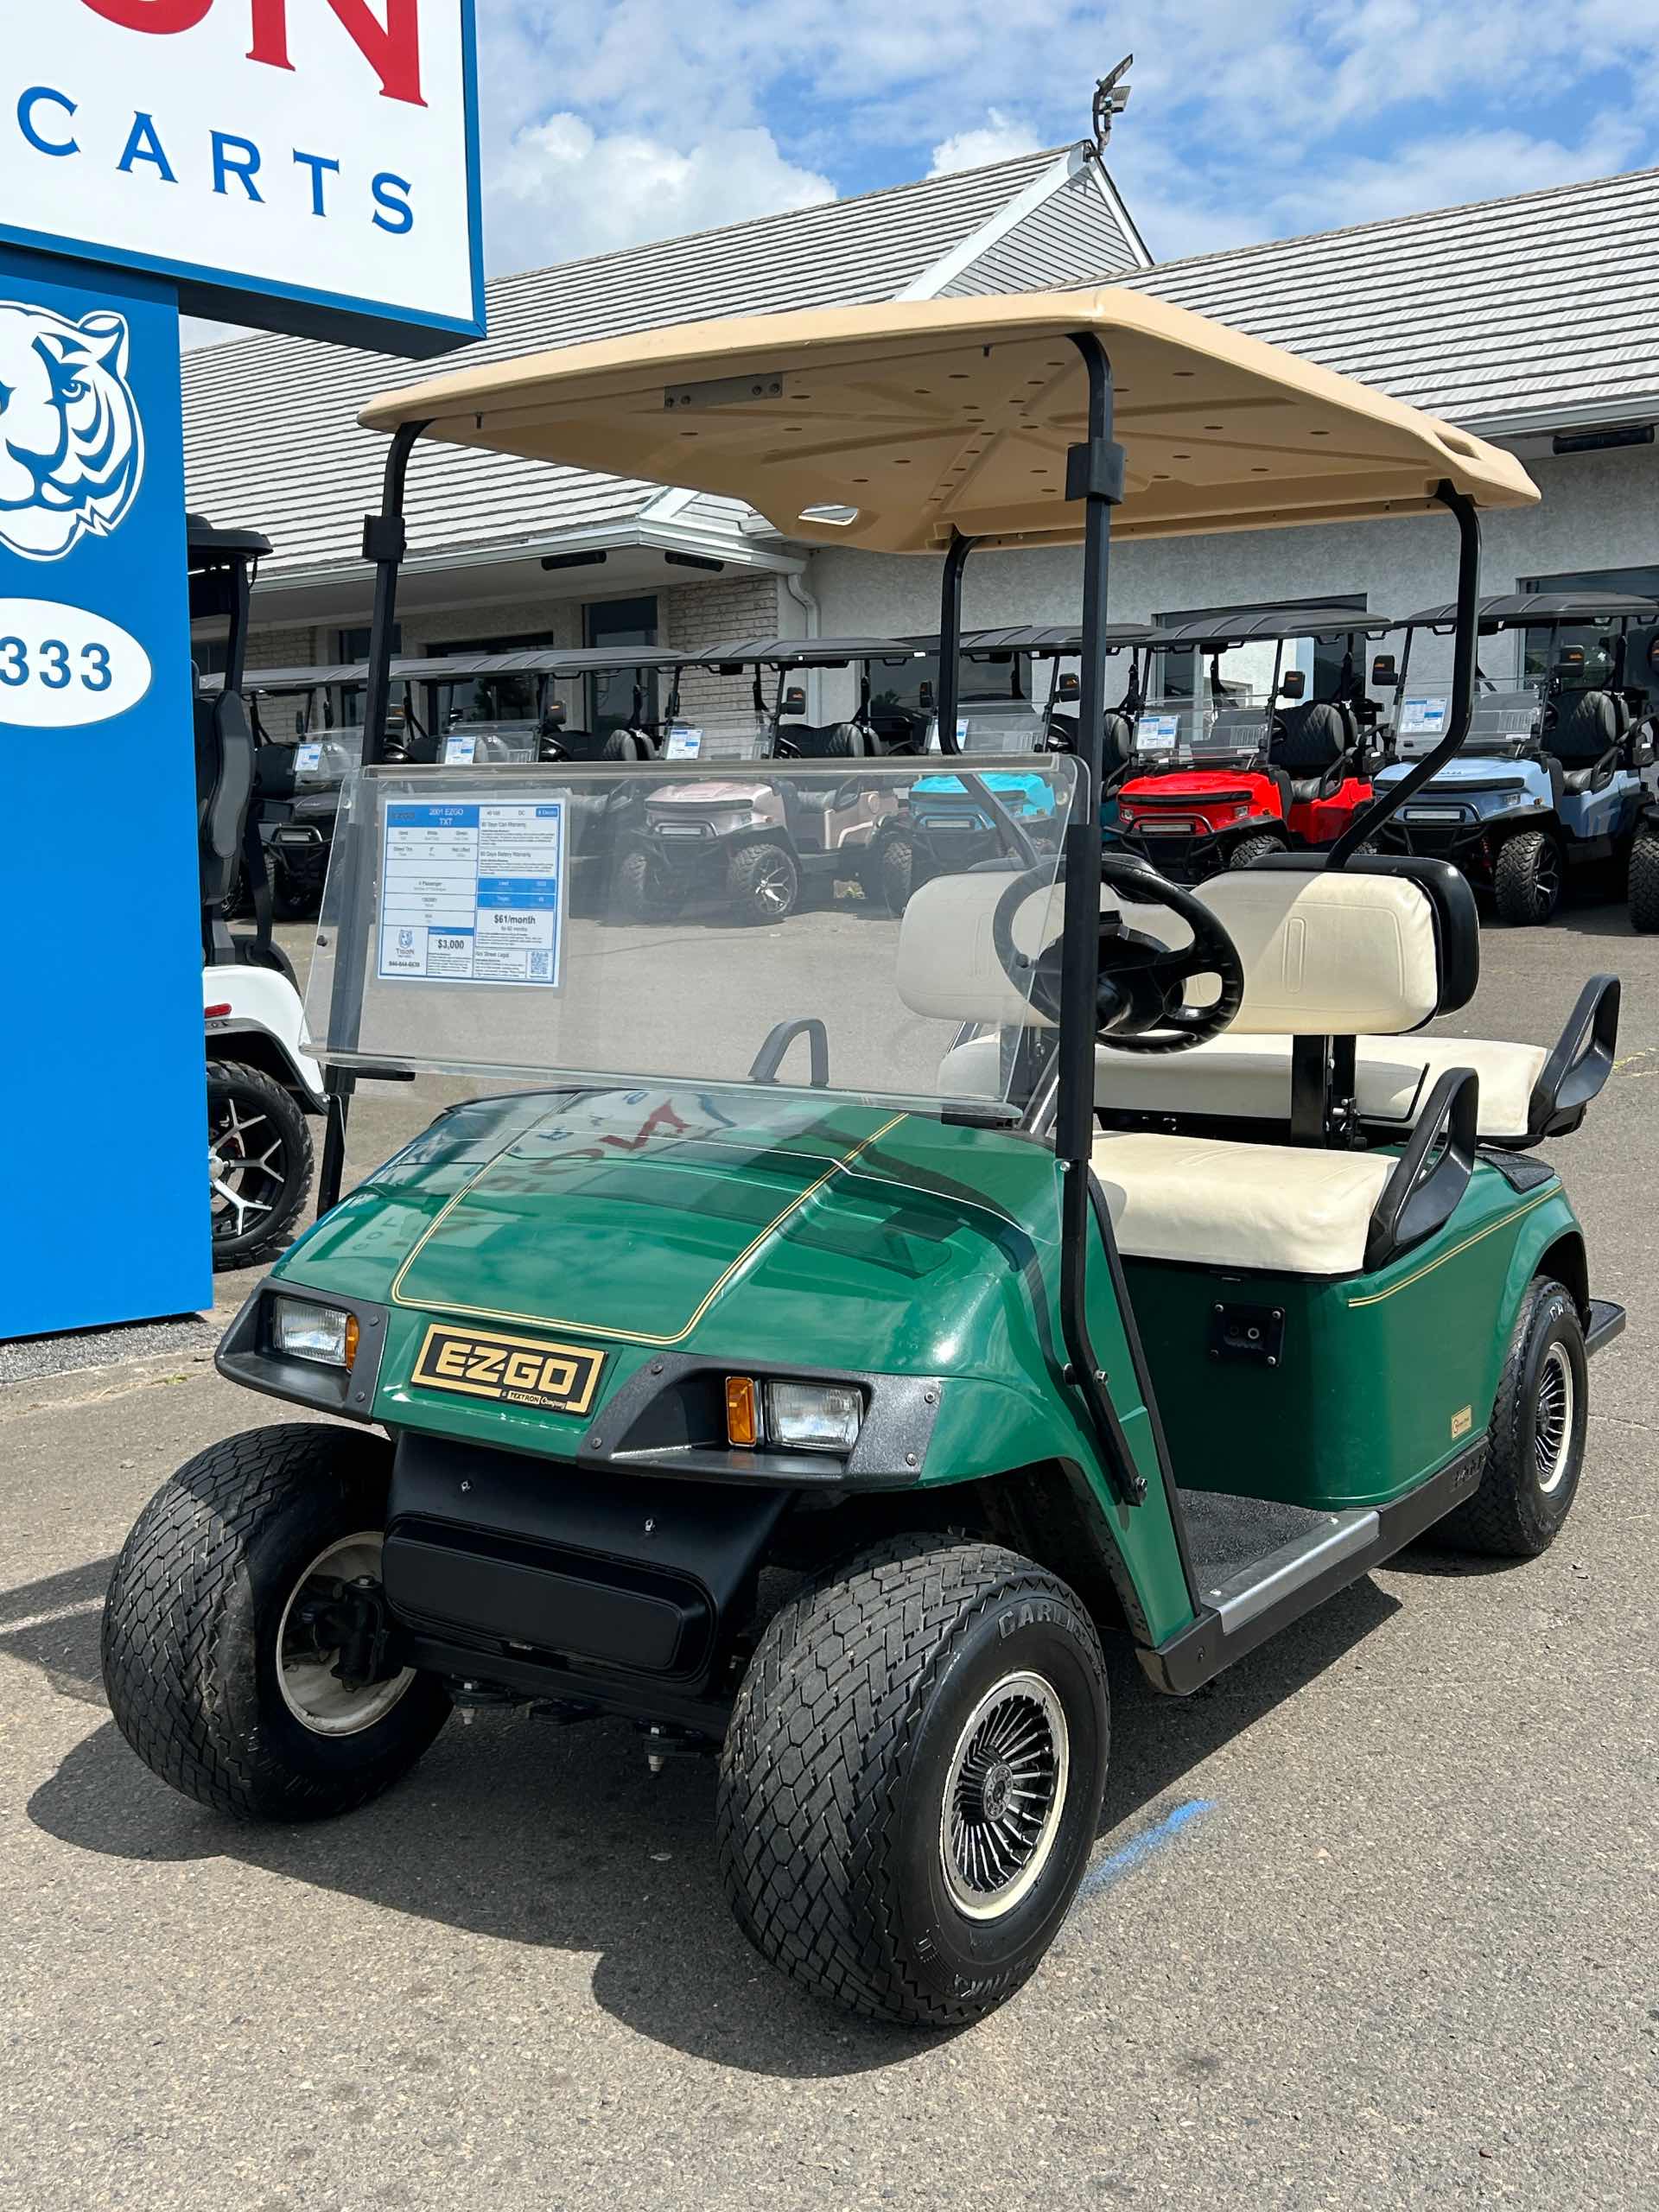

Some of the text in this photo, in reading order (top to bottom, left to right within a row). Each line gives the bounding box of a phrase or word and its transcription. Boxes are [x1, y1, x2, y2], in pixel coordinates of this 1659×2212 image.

[16, 86, 415, 235] CARTS
[438, 817, 453, 826] TXT
[493, 913, 536, 925] $61/month
[437, 938, 465, 950] $3,000
[510, 1392, 540, 1402] TEXTRON
